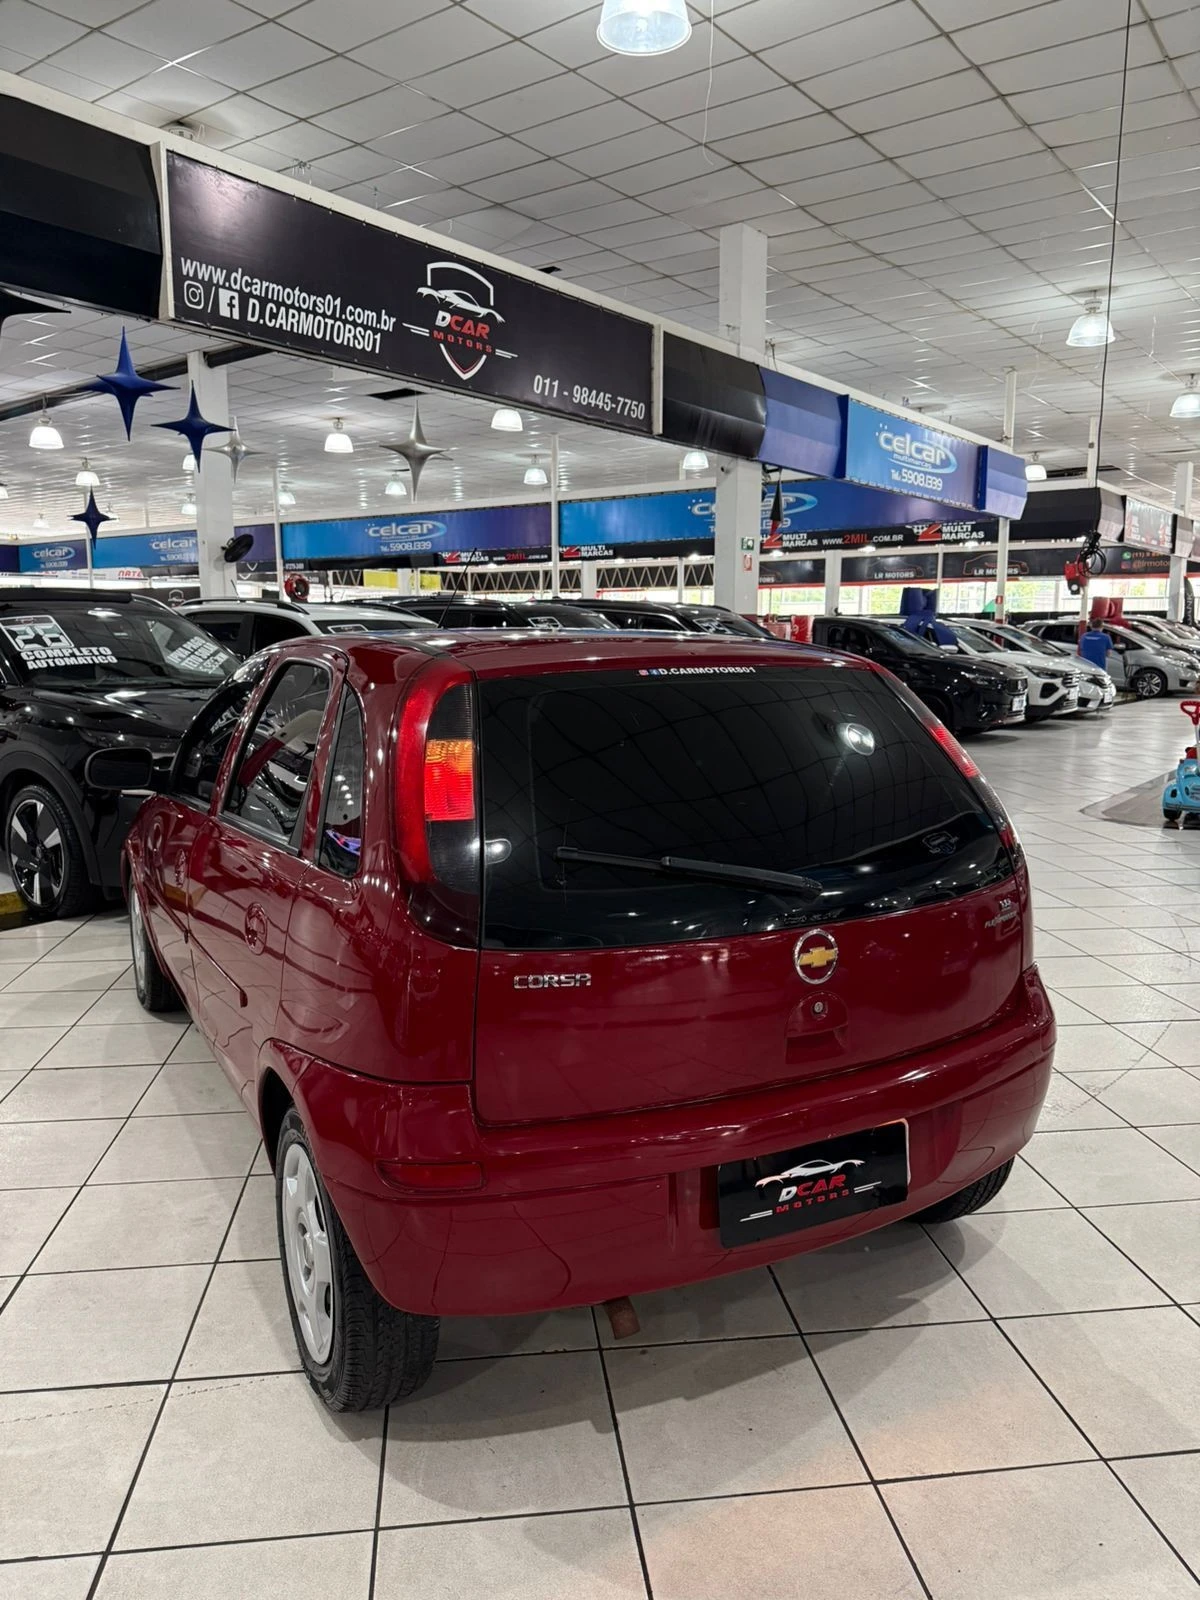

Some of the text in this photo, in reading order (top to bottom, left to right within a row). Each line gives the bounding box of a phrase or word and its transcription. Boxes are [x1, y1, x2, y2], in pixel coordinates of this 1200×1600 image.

[180, 256, 397, 332] www.dcarmotors01.com.br
[246, 297, 382, 354] D.CARMOTORS01
[435, 309, 490, 340] DCAR
[432, 330, 493, 353] MOTORS
[533, 374, 559, 398] 011
[572, 384, 646, 420] 98445-7750
[879, 430, 946, 466] celcar
[367, 522, 434, 537] celcar
[942, 531, 985, 540] MARCAS
[152, 538, 196, 549] celcar
[782, 539, 818, 547] MARCAS
[33, 548, 68, 558] celcar
[874, 571, 914, 579] LR MOTORS
[986, 567, 1018, 575] MORS
[20, 647, 113, 661] COMPLETO
[26, 655, 119, 670] AUTOMATICO
[659, 666, 757, 676] D.CARMOTORS01
[513, 973, 592, 989] CORSA
[778, 1174, 847, 1202] DCAR
[775, 1189, 849, 1213] MOTORS
